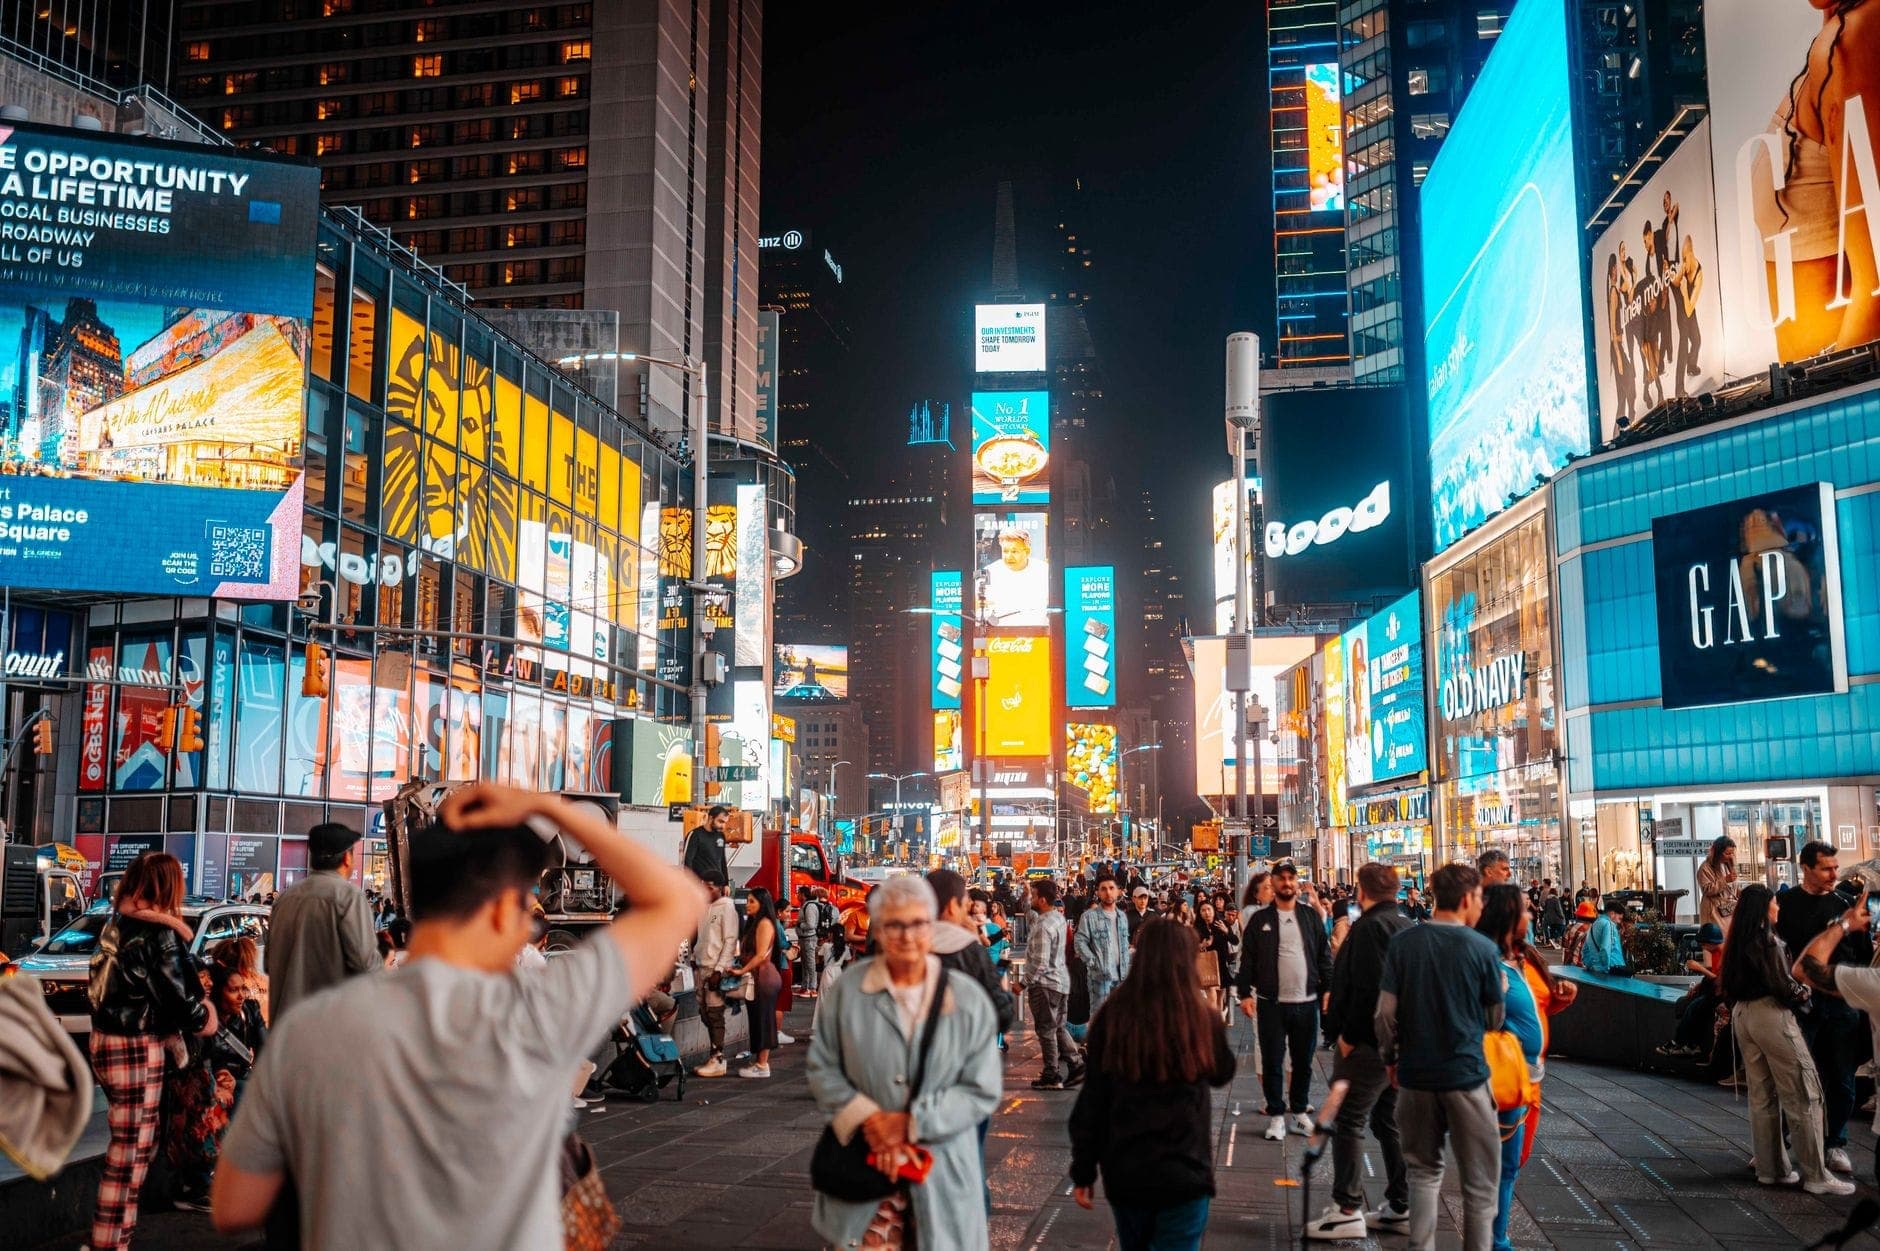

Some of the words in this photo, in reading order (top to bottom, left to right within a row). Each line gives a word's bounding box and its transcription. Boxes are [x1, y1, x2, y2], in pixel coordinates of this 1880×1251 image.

[24, 149, 249, 196] OPPORTUNITY
[1, 171, 24, 196] A
[32, 174, 173, 213] LIFETIME
[58, 206, 171, 234] BUSINESSES
[0, 220, 95, 248] ROADWAY
[758, 237, 780, 248] anz
[27, 247, 52, 264] OF
[58, 250, 83, 268] US
[981, 327, 993, 336] OUR
[994, 326, 1035, 336] INVESTMENTS
[981, 336, 1000, 344] SHAPE
[1001, 335, 1036, 344] TOMORROW
[981, 345, 1001, 353] TODAY
[1018, 398, 1029, 415] 1
[176, 417, 215, 430] PALACE
[565, 453, 595, 500] THE
[18, 503, 89, 524] Palace
[1264, 480, 1391, 558] Good
[0, 521, 70, 543] Square
[984, 520, 1039, 531] SAMSUNG
[169, 552, 185, 560] JOIN
[1081, 583, 1110, 592] MORE
[1687, 550, 1788, 651] GAP
[213, 648, 228, 714] NEWS
[1443, 672, 1474, 722] OLD
[1476, 650, 1526, 714] NAVY
[719, 767, 729, 779] W
[733, 767, 746, 780] 44
[1477, 807, 1490, 826] OLD
[1490, 804, 1512, 826] NAVY
